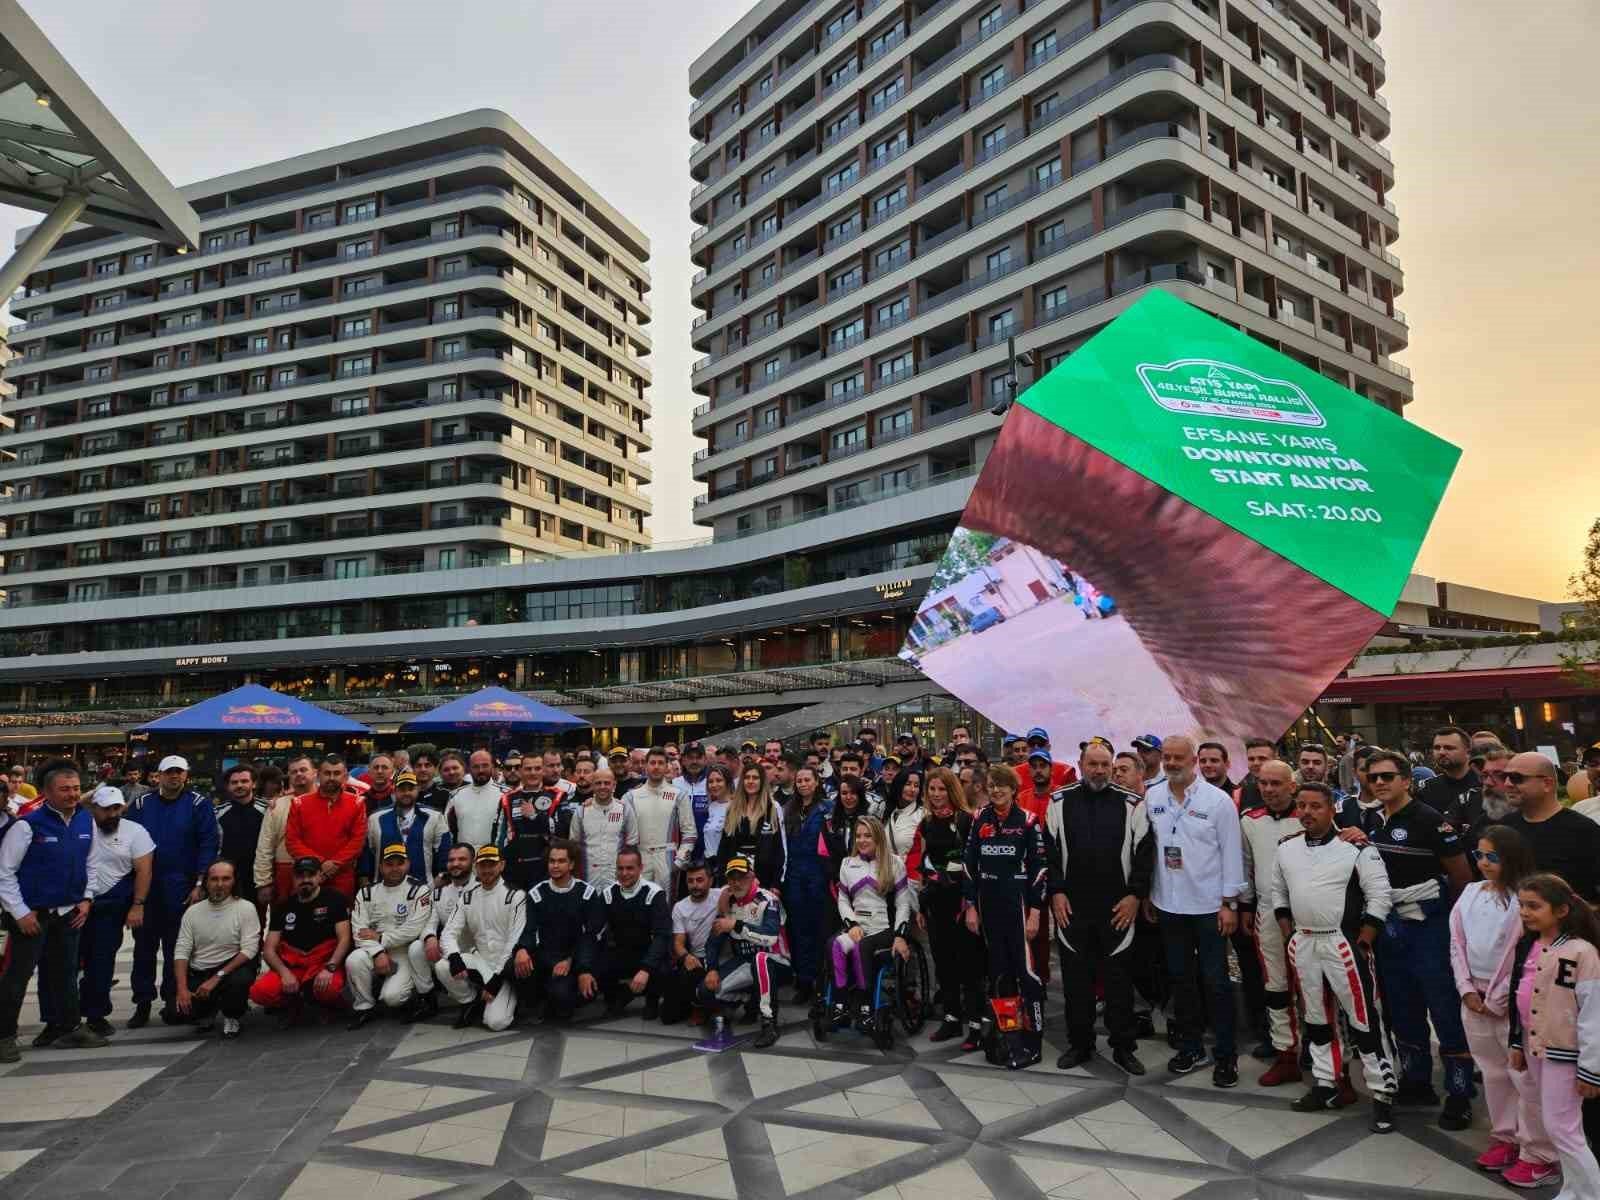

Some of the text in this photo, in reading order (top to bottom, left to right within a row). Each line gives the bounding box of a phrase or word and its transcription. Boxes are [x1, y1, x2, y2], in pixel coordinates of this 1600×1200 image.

[1213, 388, 1256, 401] BURSA
[1183, 426, 1338, 455] EFSANE YARIŞ
[1182, 446, 1369, 473] DOWNTOWN'DA
[1210, 469, 1374, 493] START ALIYOR
[1246, 501, 1383, 523] SAAT: 20.00
[175, 657, 199, 666] HAPPY
[981, 845, 1016, 856] sparco
[1555, 957, 1578, 989] E
